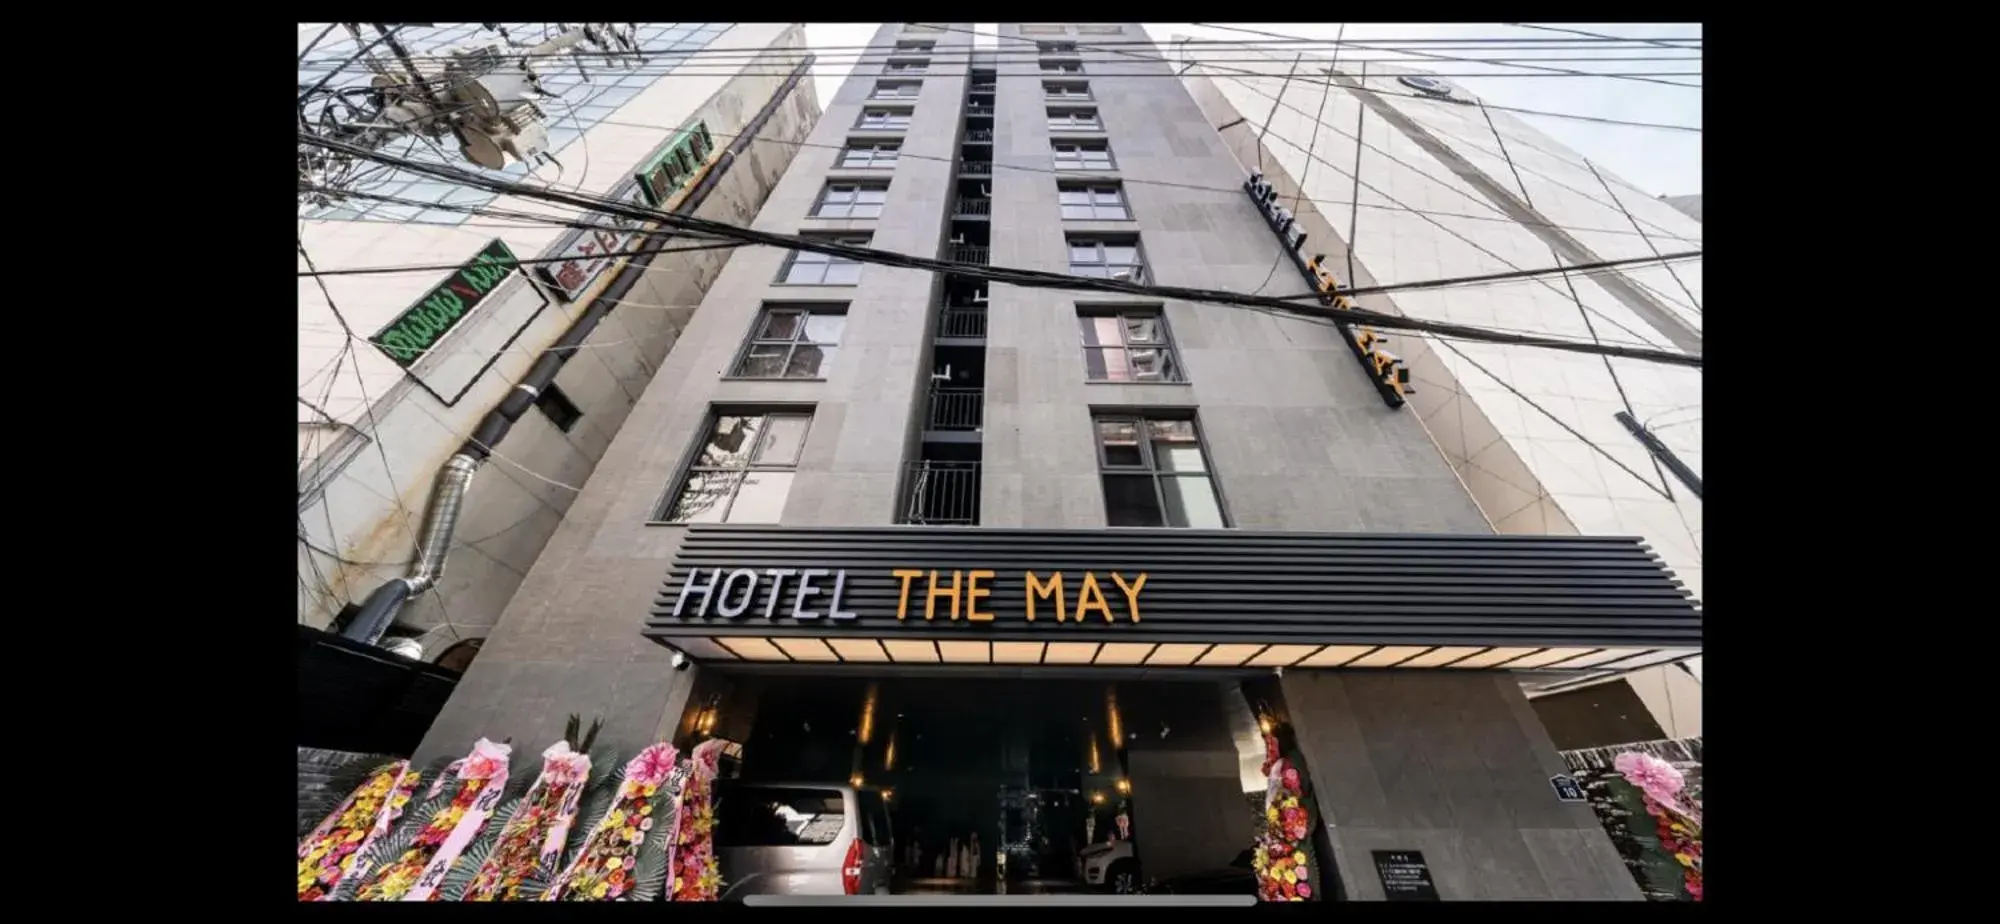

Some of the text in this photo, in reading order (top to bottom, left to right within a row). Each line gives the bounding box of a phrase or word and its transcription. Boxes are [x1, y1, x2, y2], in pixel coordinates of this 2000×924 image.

[672, 567, 1148, 623] HOTEL THE MAY
[1563, 787, 1577, 798] 10
